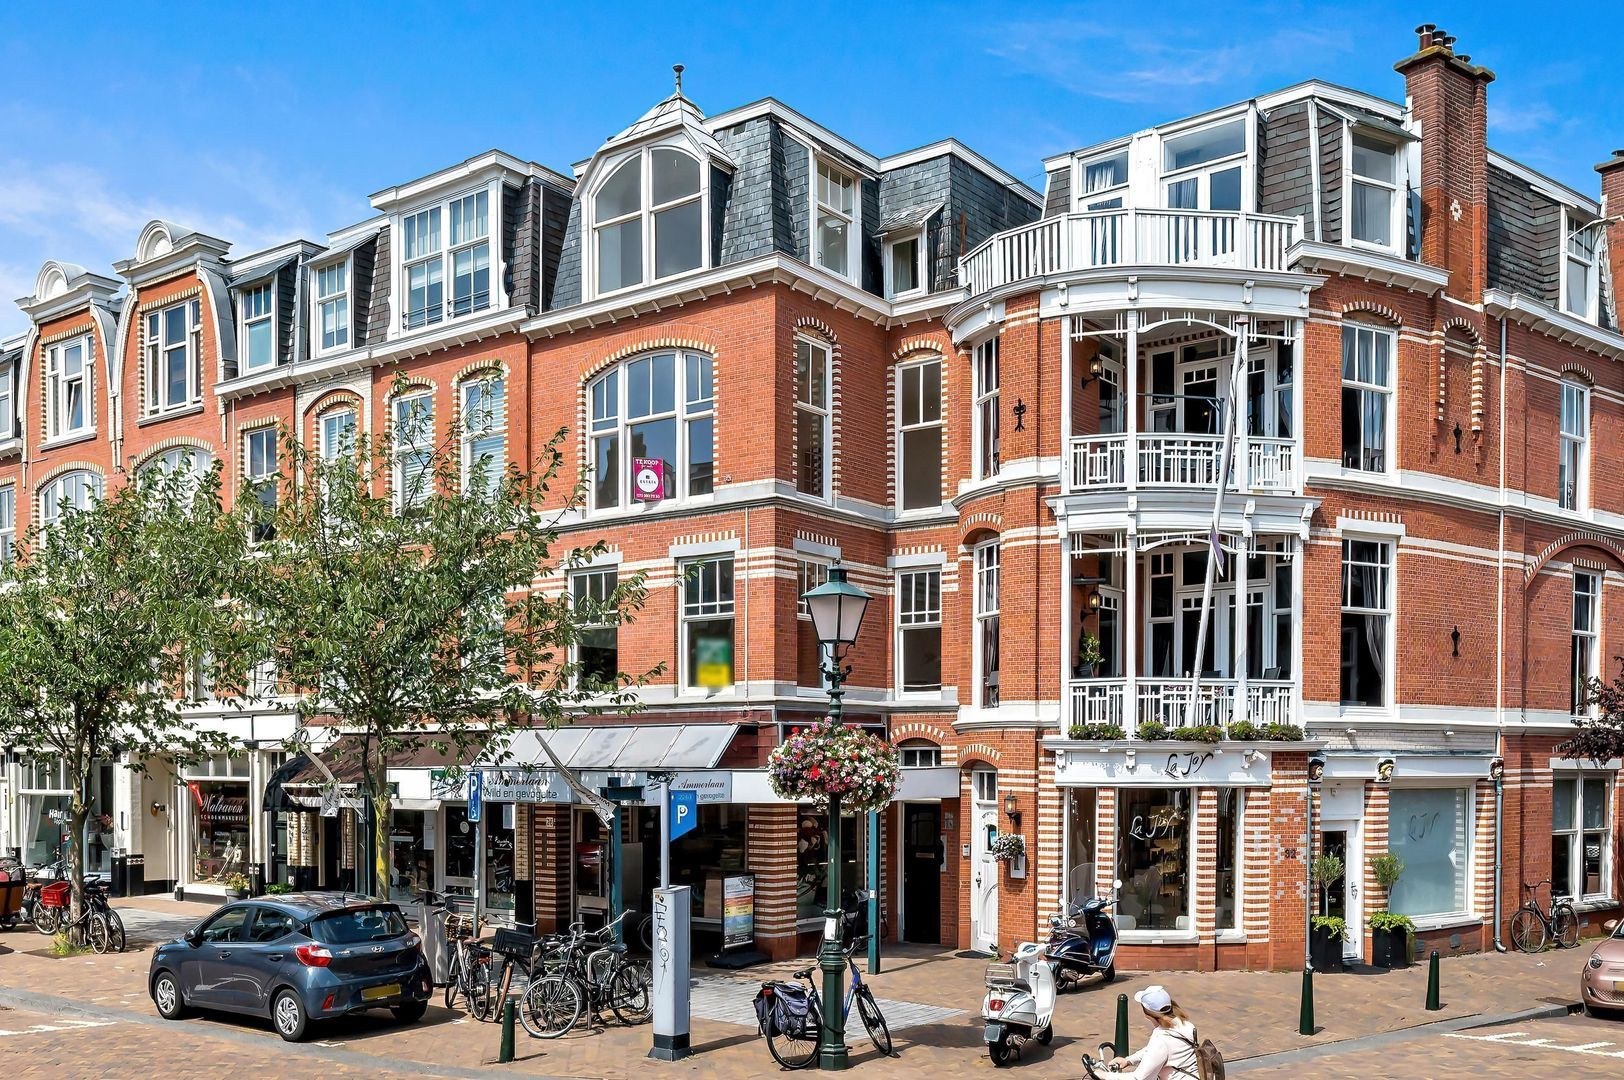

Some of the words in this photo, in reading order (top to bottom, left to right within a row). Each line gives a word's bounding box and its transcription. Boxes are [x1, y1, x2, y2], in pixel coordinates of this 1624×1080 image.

[1164, 753, 1180, 779] La
[1181, 752, 1214, 776] Joy
[470, 775, 478, 800] P
[488, 775, 549, 787] Ammerlaan
[678, 778, 725, 790] Ammerlaan
[503, 790, 514, 799] en
[48, 808, 63, 819] Hair
[677, 804, 688, 824] P
[1128, 815, 1145, 841] La
[1145, 813, 1179, 838] Joy
